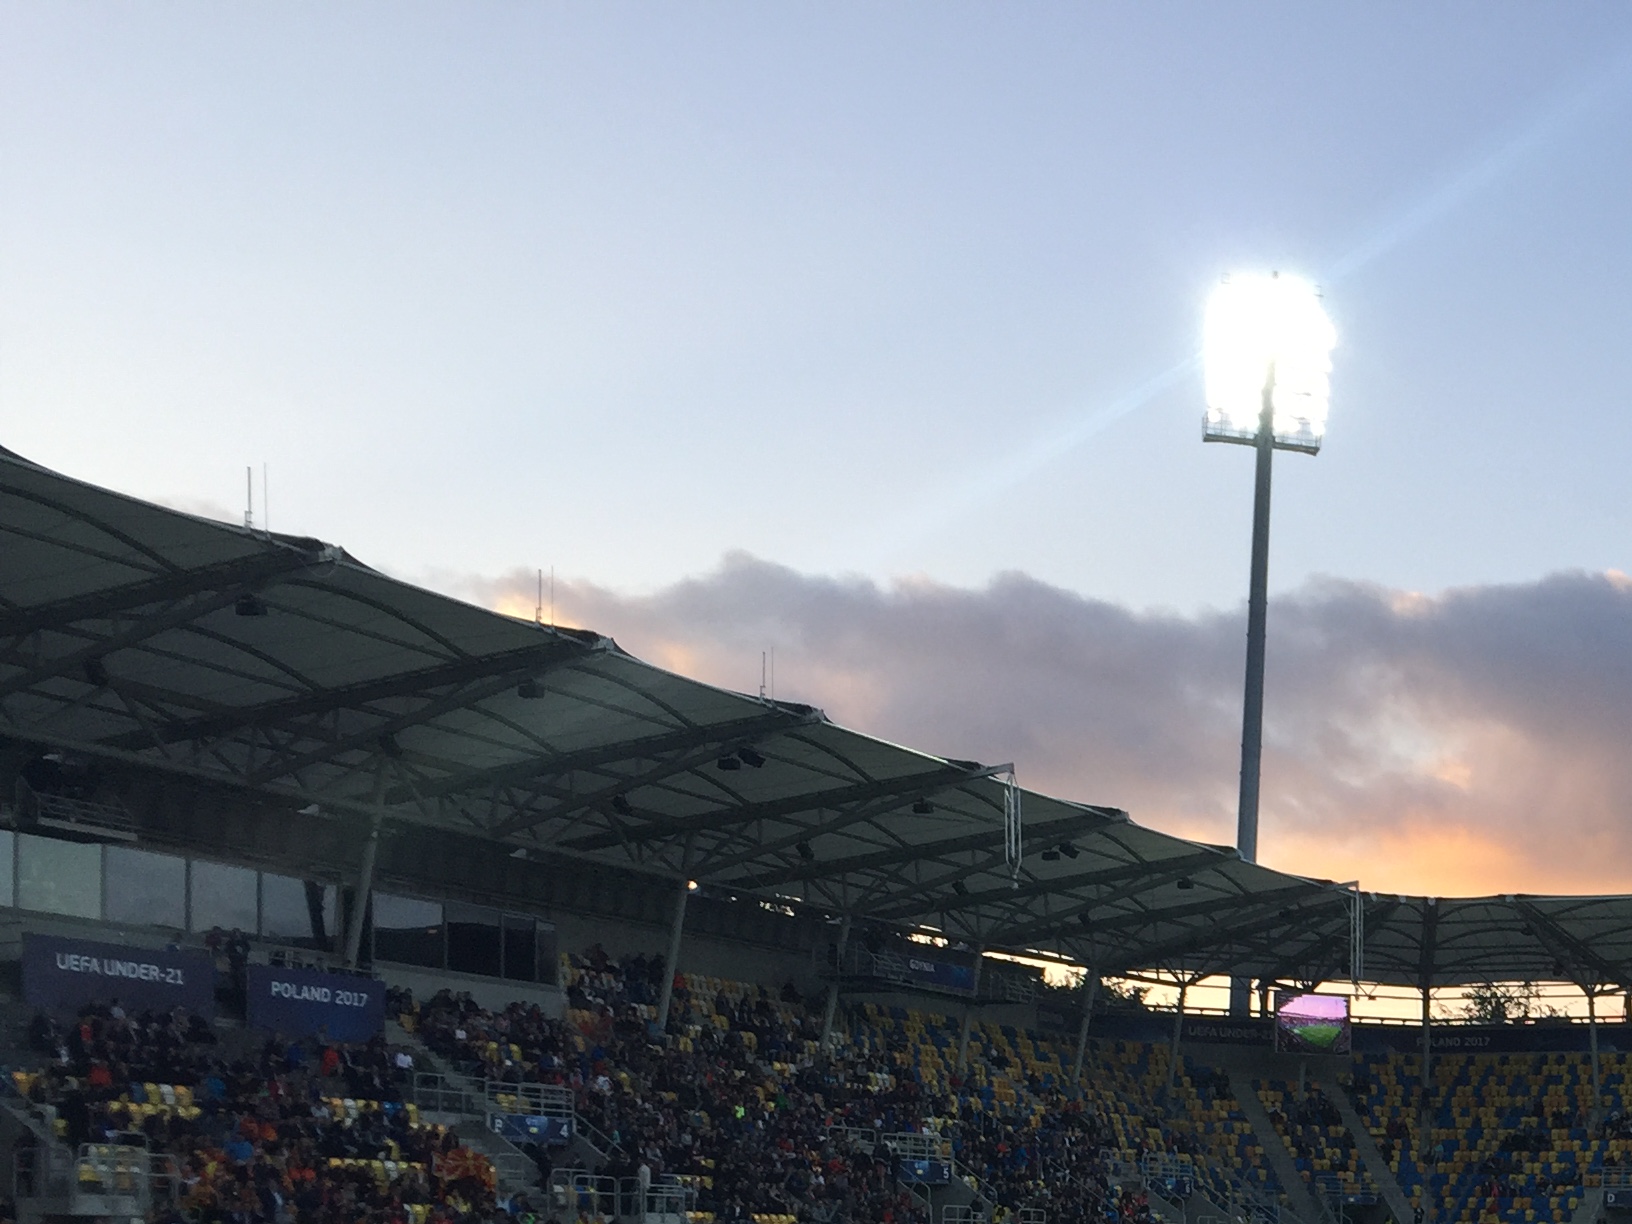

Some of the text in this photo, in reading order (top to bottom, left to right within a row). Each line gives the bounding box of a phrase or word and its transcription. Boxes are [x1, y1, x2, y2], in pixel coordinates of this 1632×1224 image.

[56, 952, 184, 985] UEFA UNDER-21
[270, 981, 368, 1007] POLAND 2017
[1416, 1036, 1491, 1047] PLAND 2017
[943, 1167, 949, 1179] 5
[1607, 1193, 1615, 1203] D
